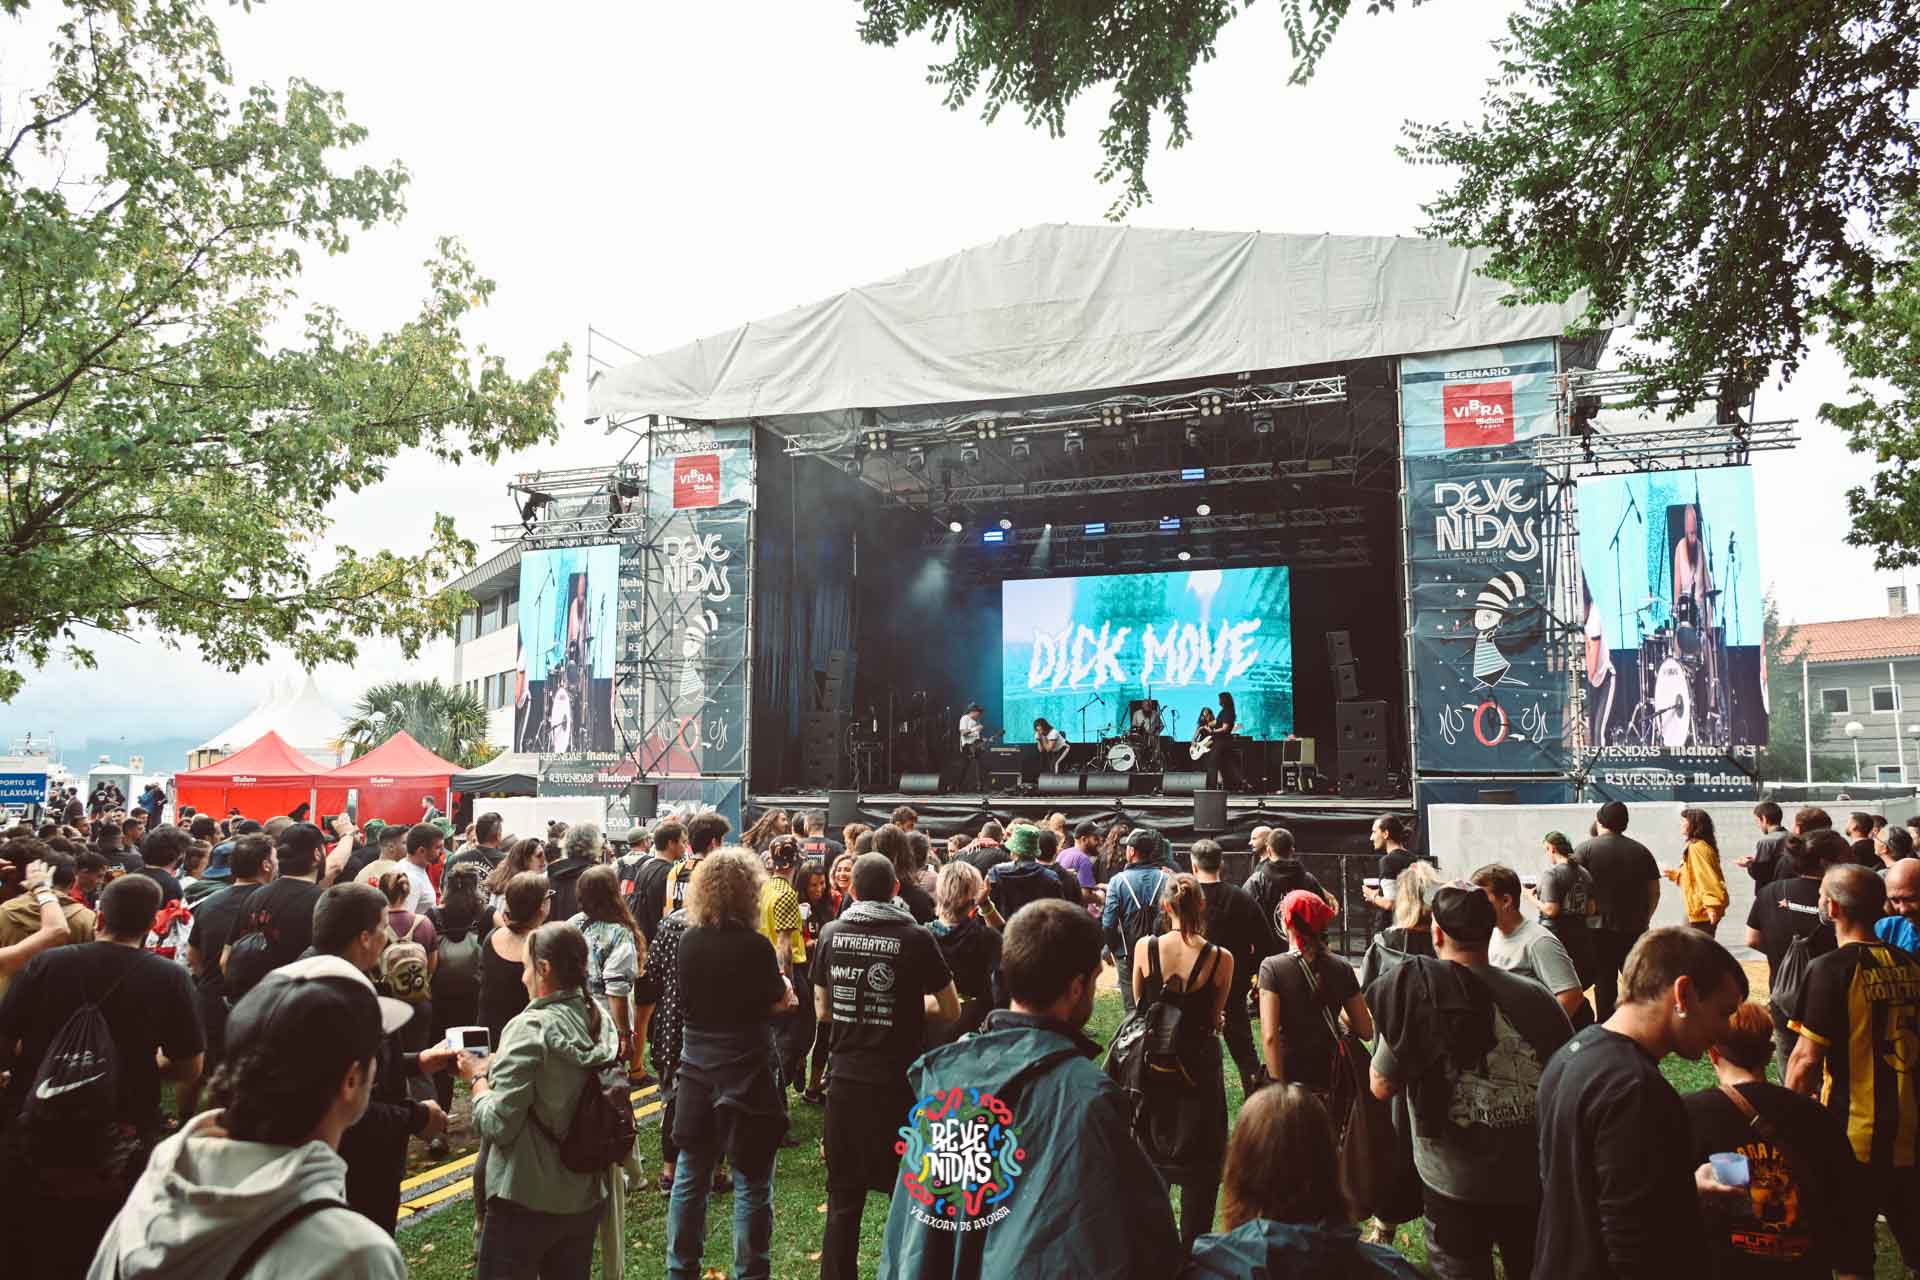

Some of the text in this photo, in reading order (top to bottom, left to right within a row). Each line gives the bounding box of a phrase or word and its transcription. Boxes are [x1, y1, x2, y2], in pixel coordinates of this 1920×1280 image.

[1444, 367, 1511, 380] ESCENARIO
[1452, 399, 1505, 418] VIBRA
[679, 468, 714, 485] VIBRA
[1434, 477, 1538, 520] REVE
[1436, 511, 1540, 562] NIDAS
[1028, 617, 1262, 691] DICK MOVE
[1694, 772, 1752, 786] Mahou
[832, 935, 901, 954] ENTREBATEAS
